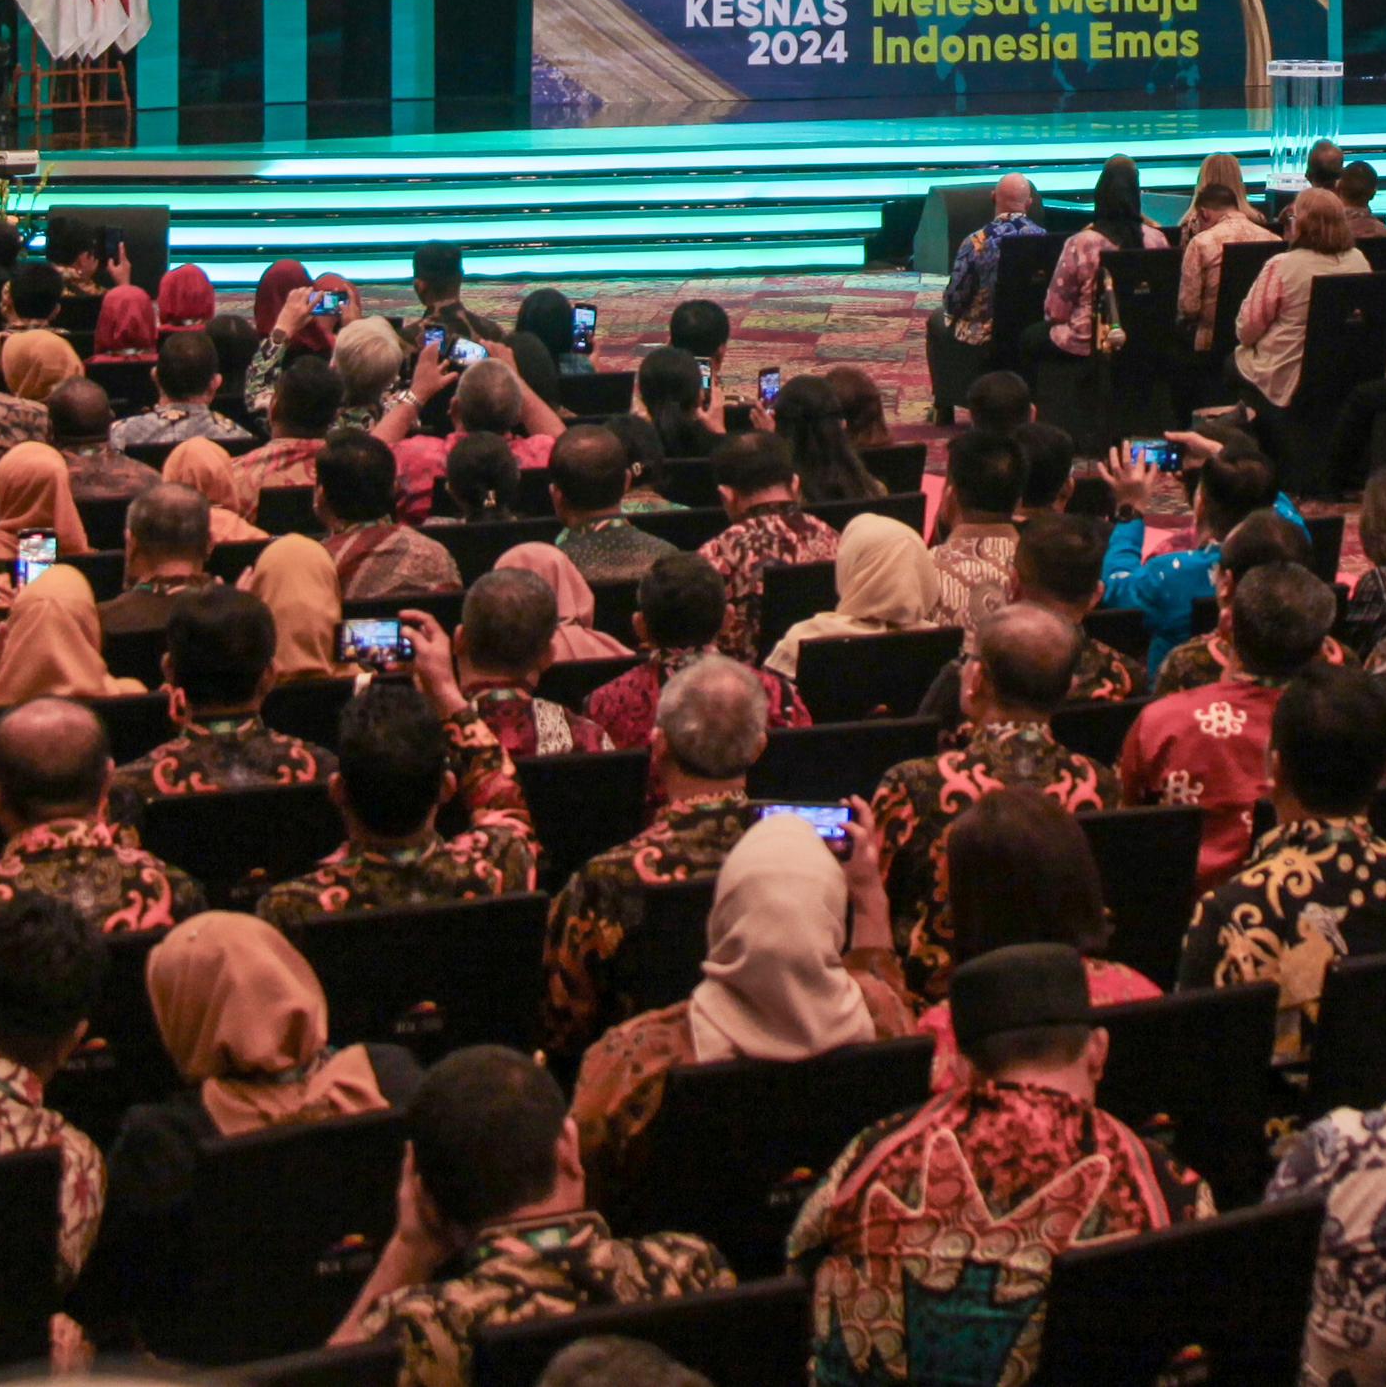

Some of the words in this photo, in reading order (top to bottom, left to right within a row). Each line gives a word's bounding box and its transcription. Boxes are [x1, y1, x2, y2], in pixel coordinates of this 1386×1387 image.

[749, 30, 848, 65] 2024
[872, 27, 1079, 65] Indonesia
[1088, 23, 1200, 61] Emas
